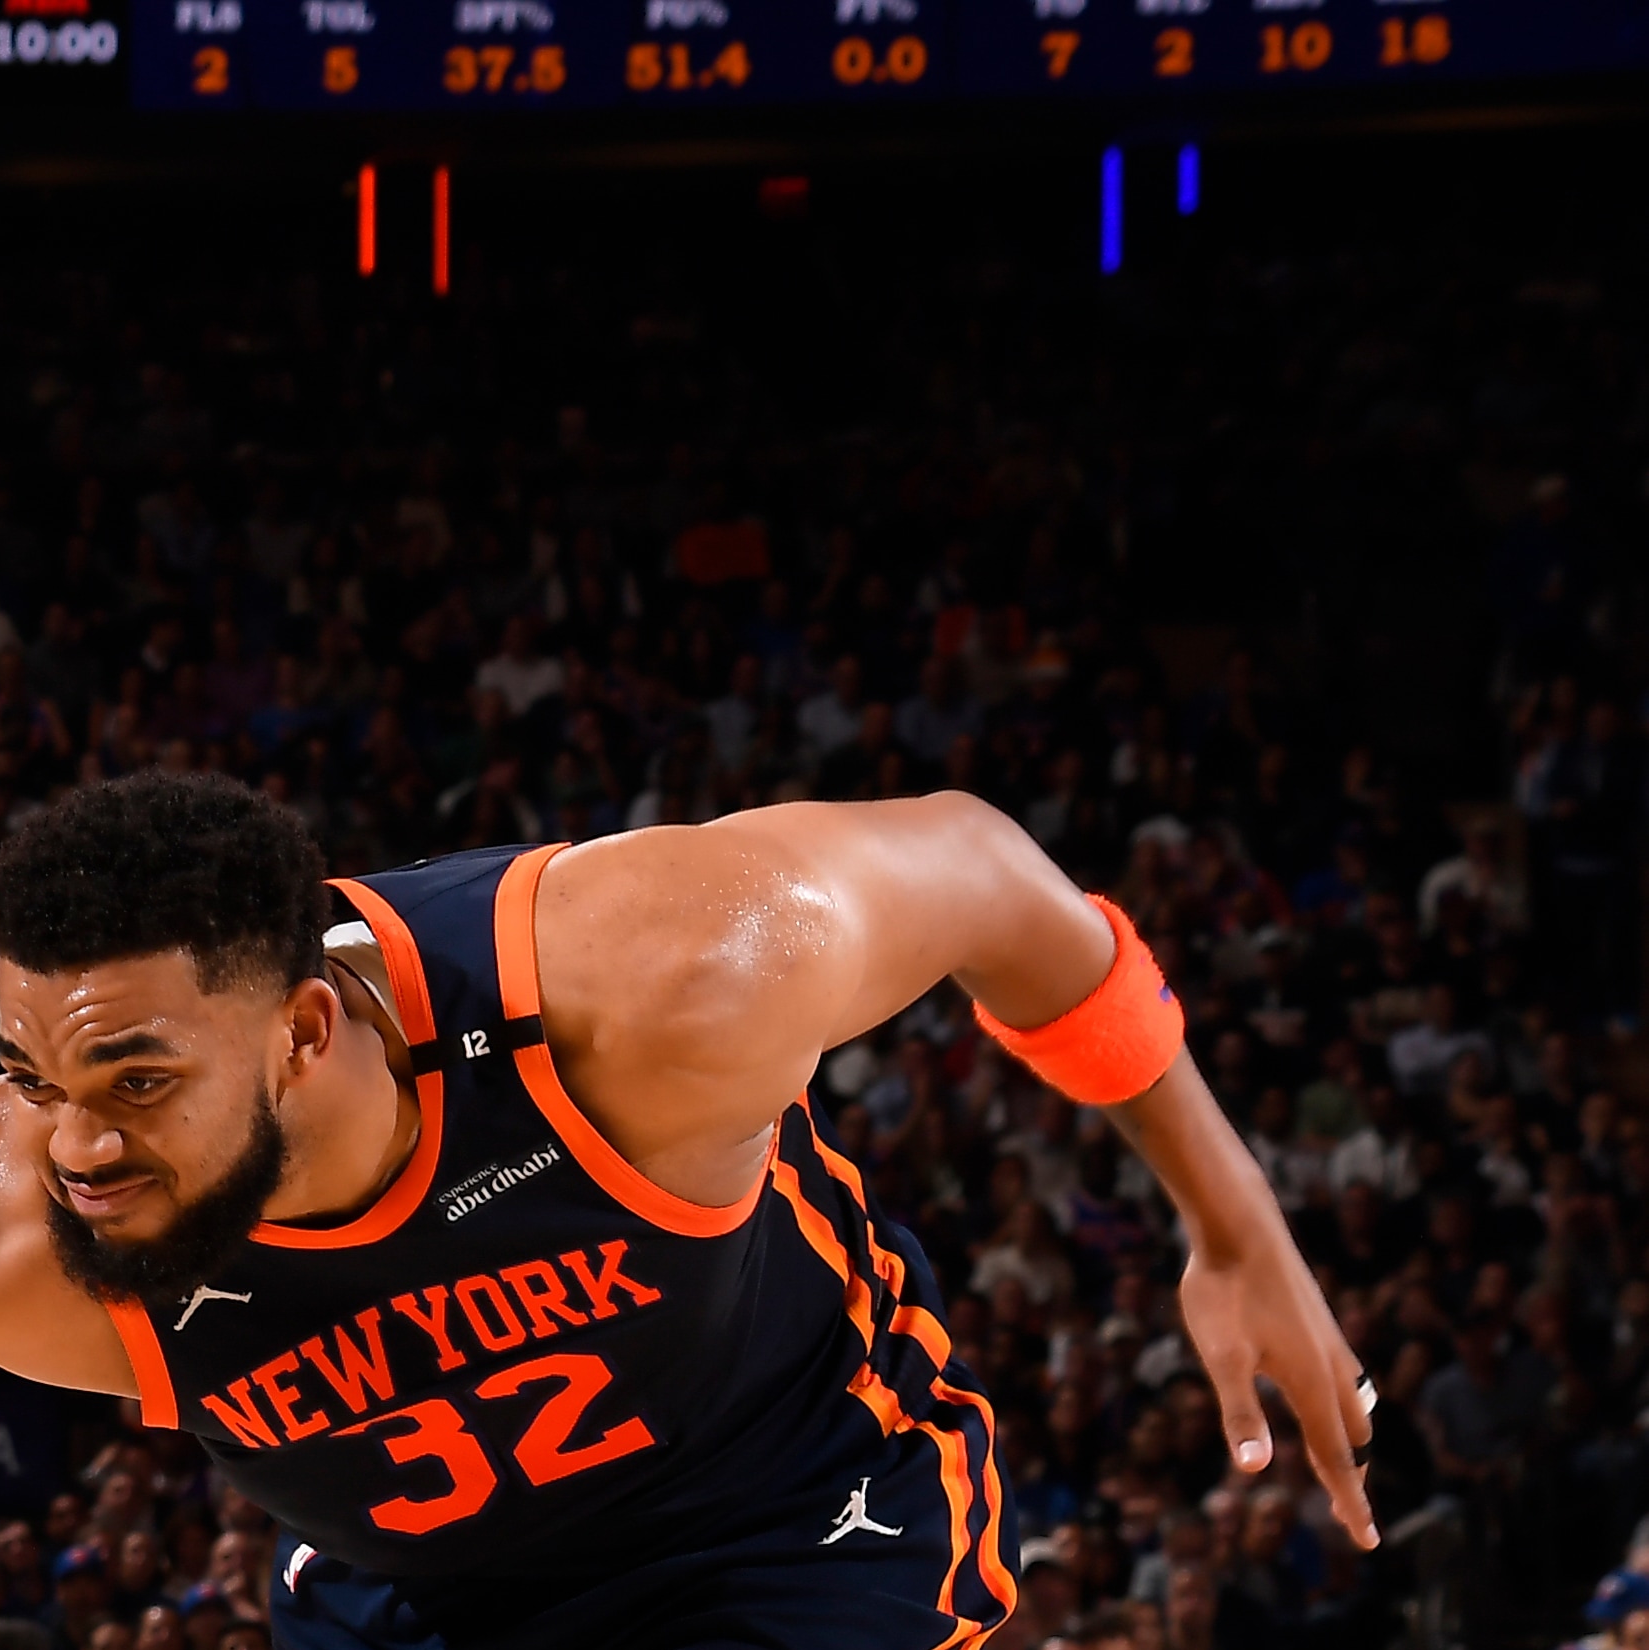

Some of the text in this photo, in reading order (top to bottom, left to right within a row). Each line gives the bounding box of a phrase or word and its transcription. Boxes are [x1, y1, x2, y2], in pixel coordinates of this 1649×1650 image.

[193, 47, 230, 93] 2
[832, 36, 928, 85] 0.0
[1040, 31, 1080, 80] 7
[1154, 27, 1195, 77] 2
[1259, 21, 1334, 73] 10
[462, 1030, 490, 1059] 12
[447, 1143, 560, 1221] abu dhabi
[200, 1239, 662, 1449] NEW YORK
[328, 1353, 657, 1536] 32
